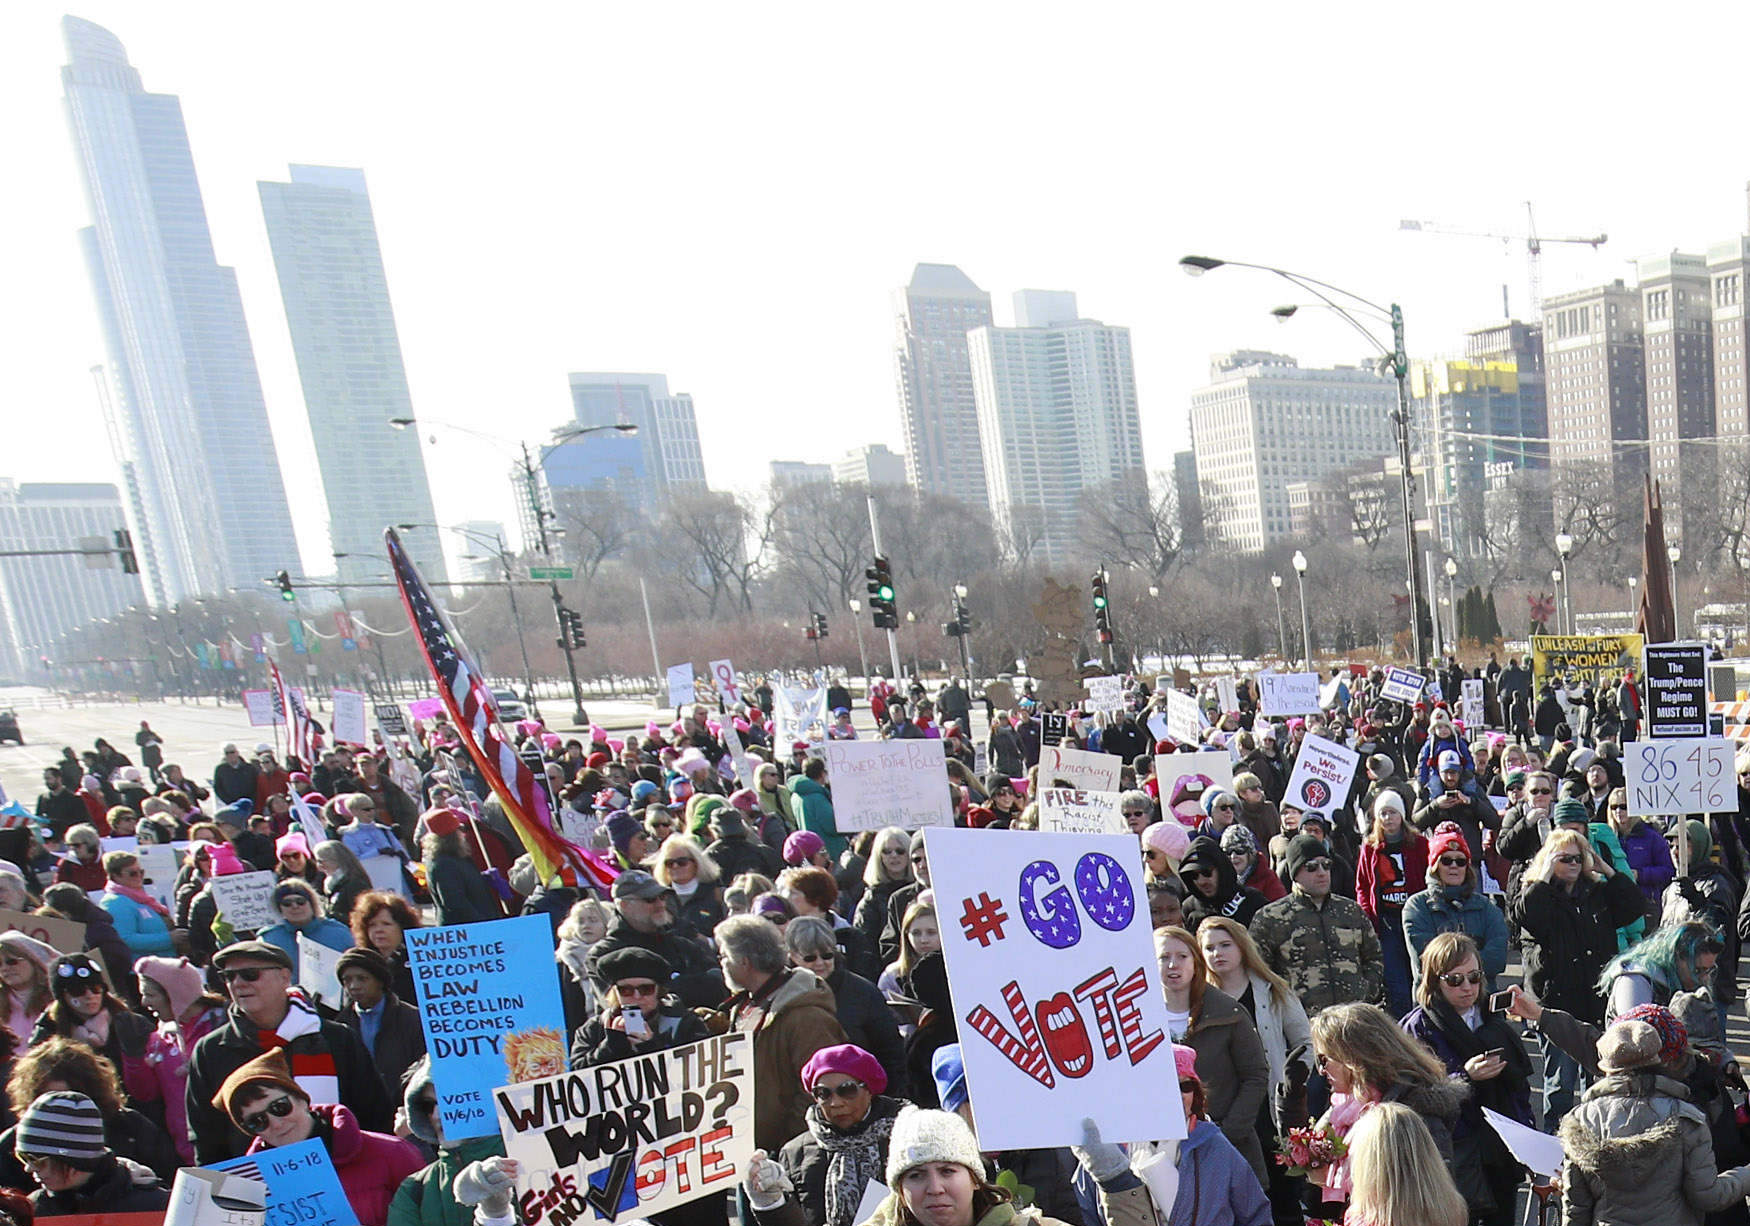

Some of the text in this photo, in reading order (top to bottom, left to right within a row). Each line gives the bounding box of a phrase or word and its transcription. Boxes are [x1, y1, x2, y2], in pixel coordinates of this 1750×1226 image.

[1537, 638, 1622, 652] UNLEASH FURY
[1564, 652, 1618, 667] WOMEN
[1667, 662, 1684, 674] The
[1392, 671, 1406, 683] VOTE
[1648, 676, 1704, 690] Trump/Pence
[1660, 691, 1693, 705] Regime
[376, 705, 401, 719] NO!
[1656, 706, 1681, 718] MUST
[1682, 706, 1699, 718] GO!
[1047, 749, 1116, 792] Democracy
[1302, 760, 1348, 785] Persist!
[1319, 757, 1337, 770] We
[1641, 745, 1724, 783] 86 45
[1044, 789, 1114, 809] FIRE this
[1636, 779, 1724, 809] NIX 46
[1061, 807, 1104, 825] Racist,
[410, 929, 468, 947] WHEN
[413, 941, 505, 963] INJUSTICE
[418, 958, 506, 980] BECOMES
[423, 979, 480, 1000] LAW
[426, 994, 525, 1017] REBELLION
[428, 1015, 516, 1034] BECOMES
[966, 965, 1166, 1090] VOTE
[433, 1034, 501, 1059] DUTY
[497, 1033, 746, 1133] WHO RUN THE
[442, 1090, 482, 1106] VOTE
[443, 1107, 486, 1125] 11/6/18
[544, 1081, 740, 1170] WORLD?
[271, 1151, 323, 1177] 11-6-18
